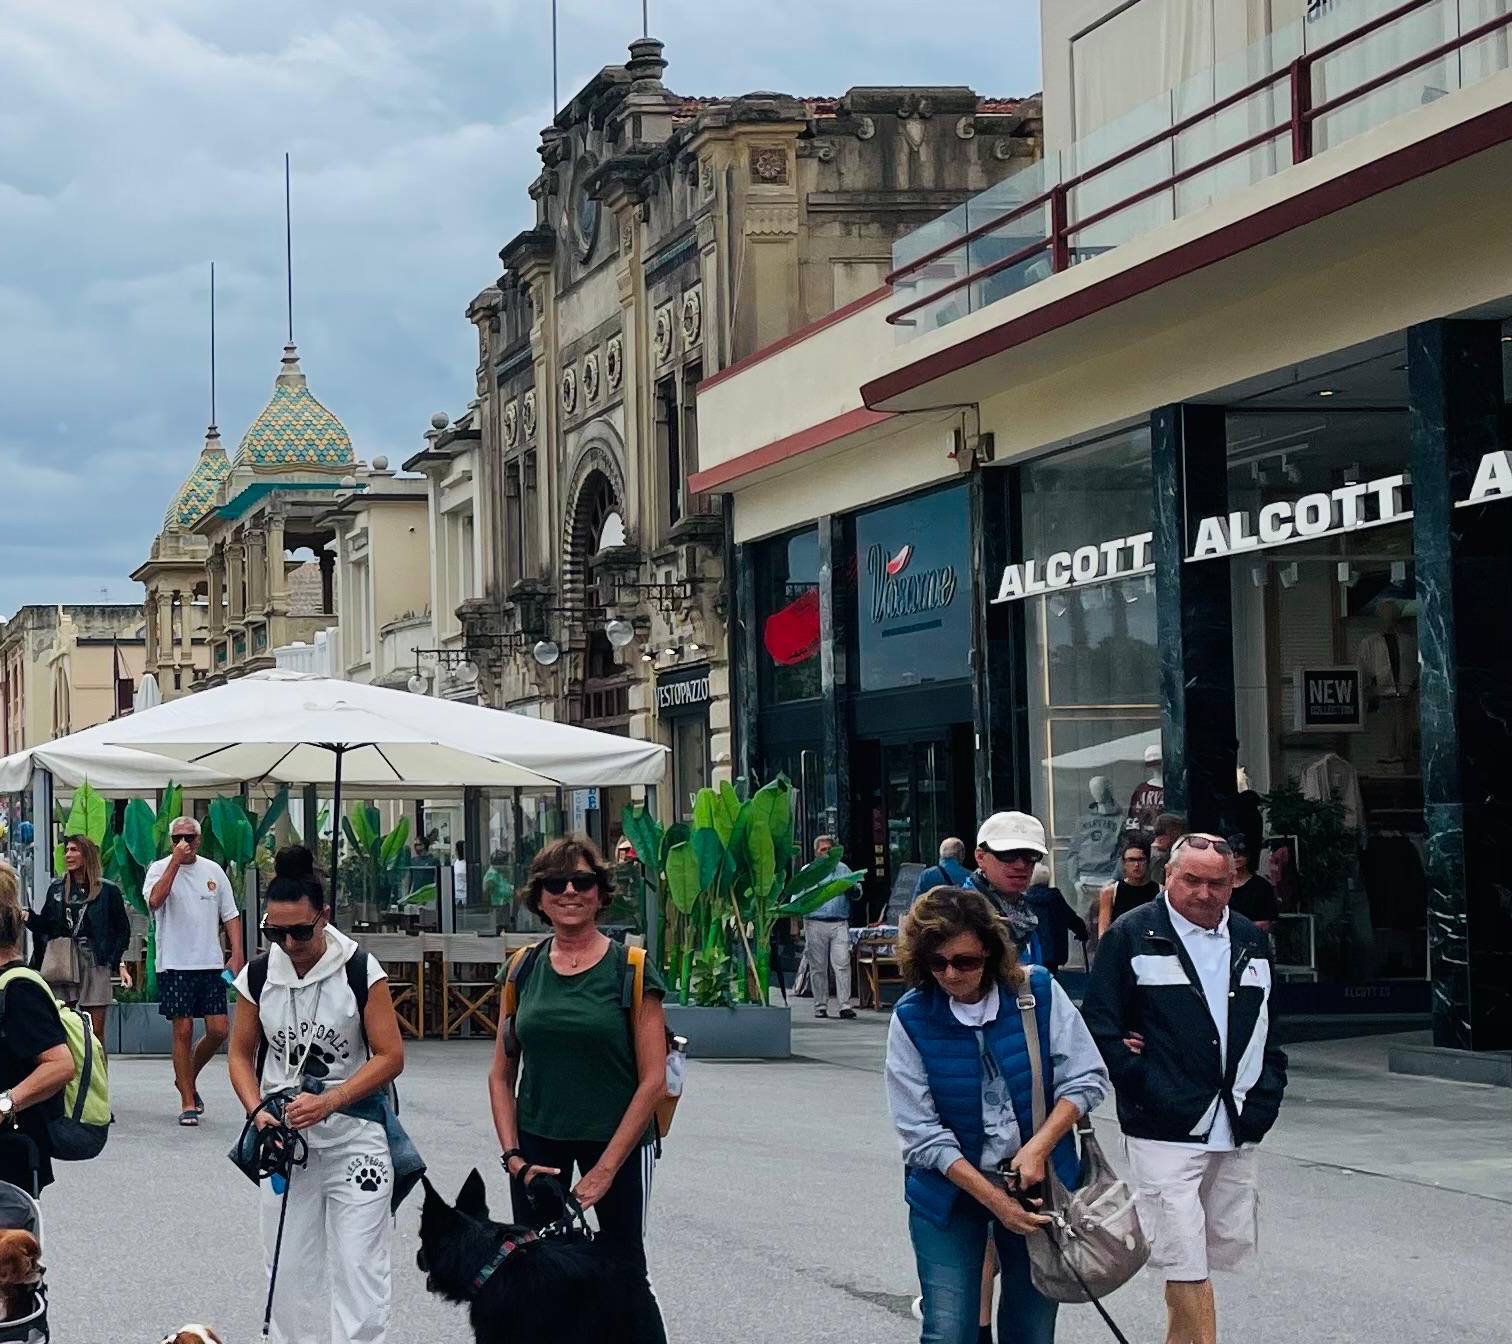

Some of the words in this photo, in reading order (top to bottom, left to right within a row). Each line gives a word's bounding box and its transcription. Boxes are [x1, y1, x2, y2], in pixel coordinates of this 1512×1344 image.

[1193, 473, 1412, 558] ALCOTT
[997, 531, 1153, 600] ALCOTT
[1309, 679, 1354, 704] NEW
